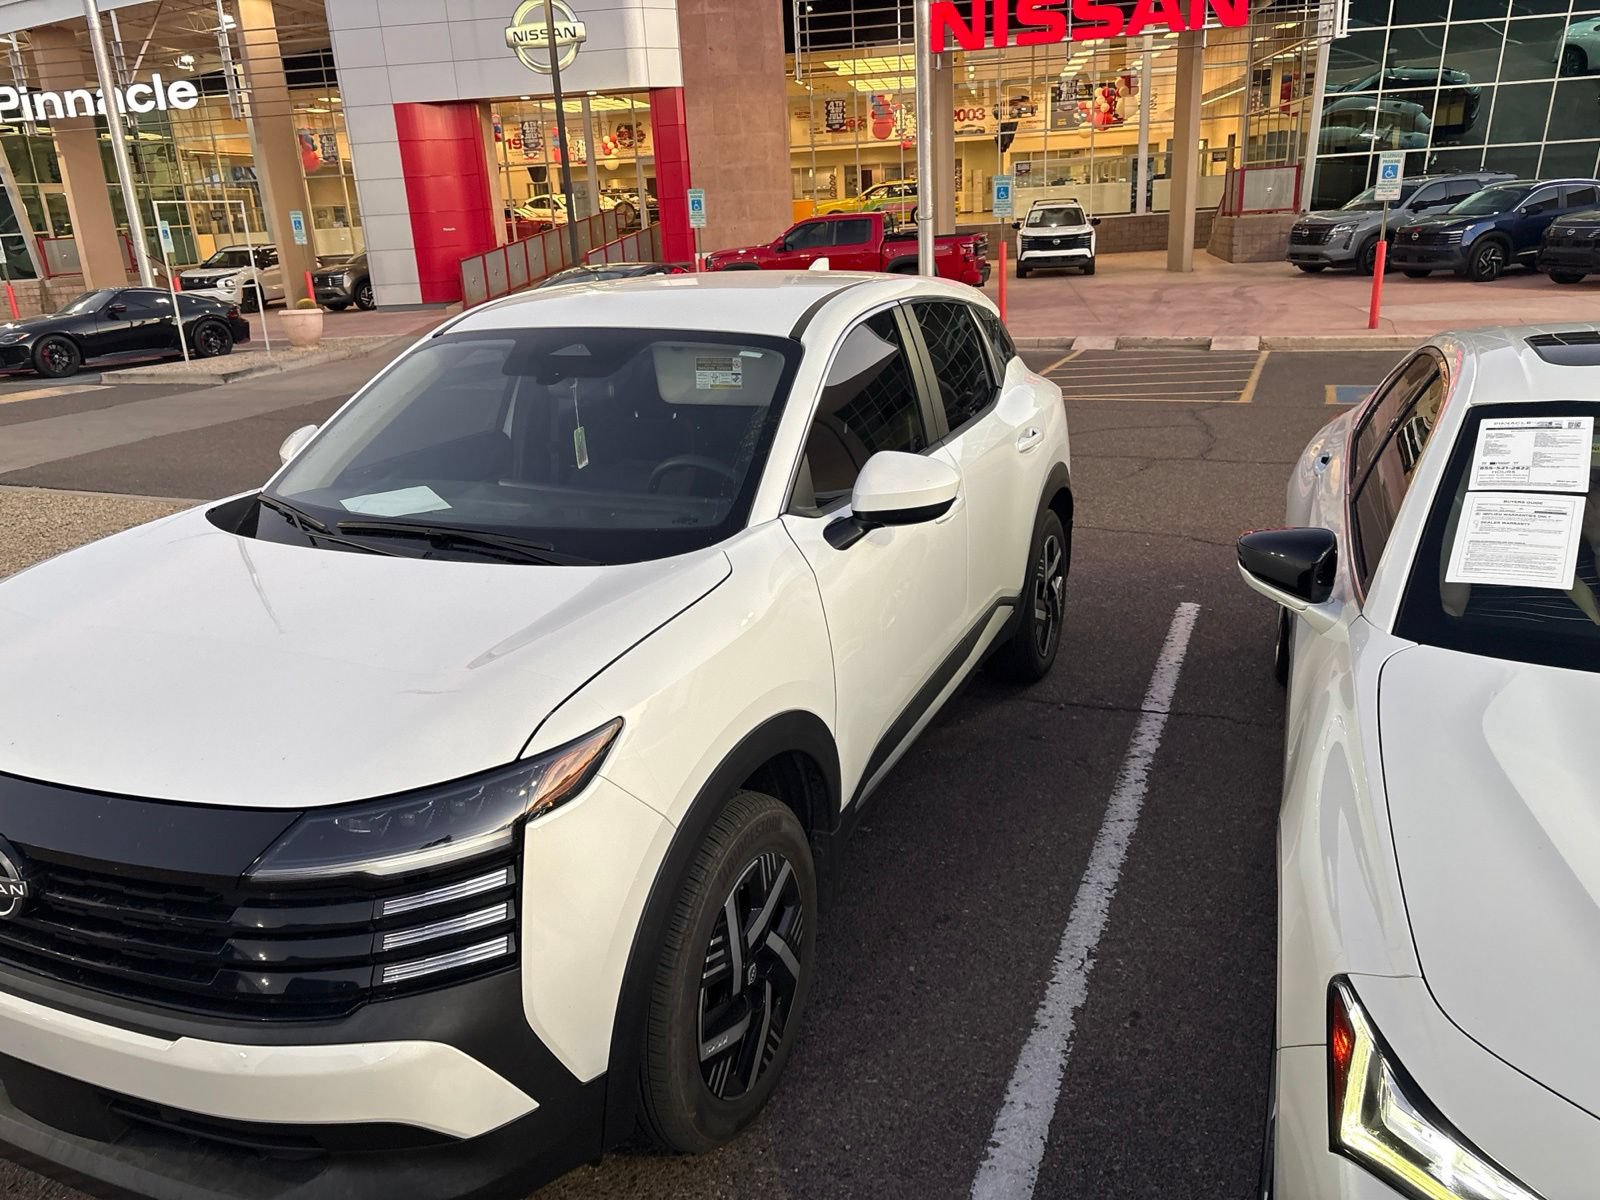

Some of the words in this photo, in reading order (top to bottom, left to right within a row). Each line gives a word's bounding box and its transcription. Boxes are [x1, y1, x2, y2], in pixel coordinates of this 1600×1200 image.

[513, 26, 577, 42] NISSAN
[930, 0, 1248, 53] NISSAN
[0, 73, 199, 122] Pinnacle
